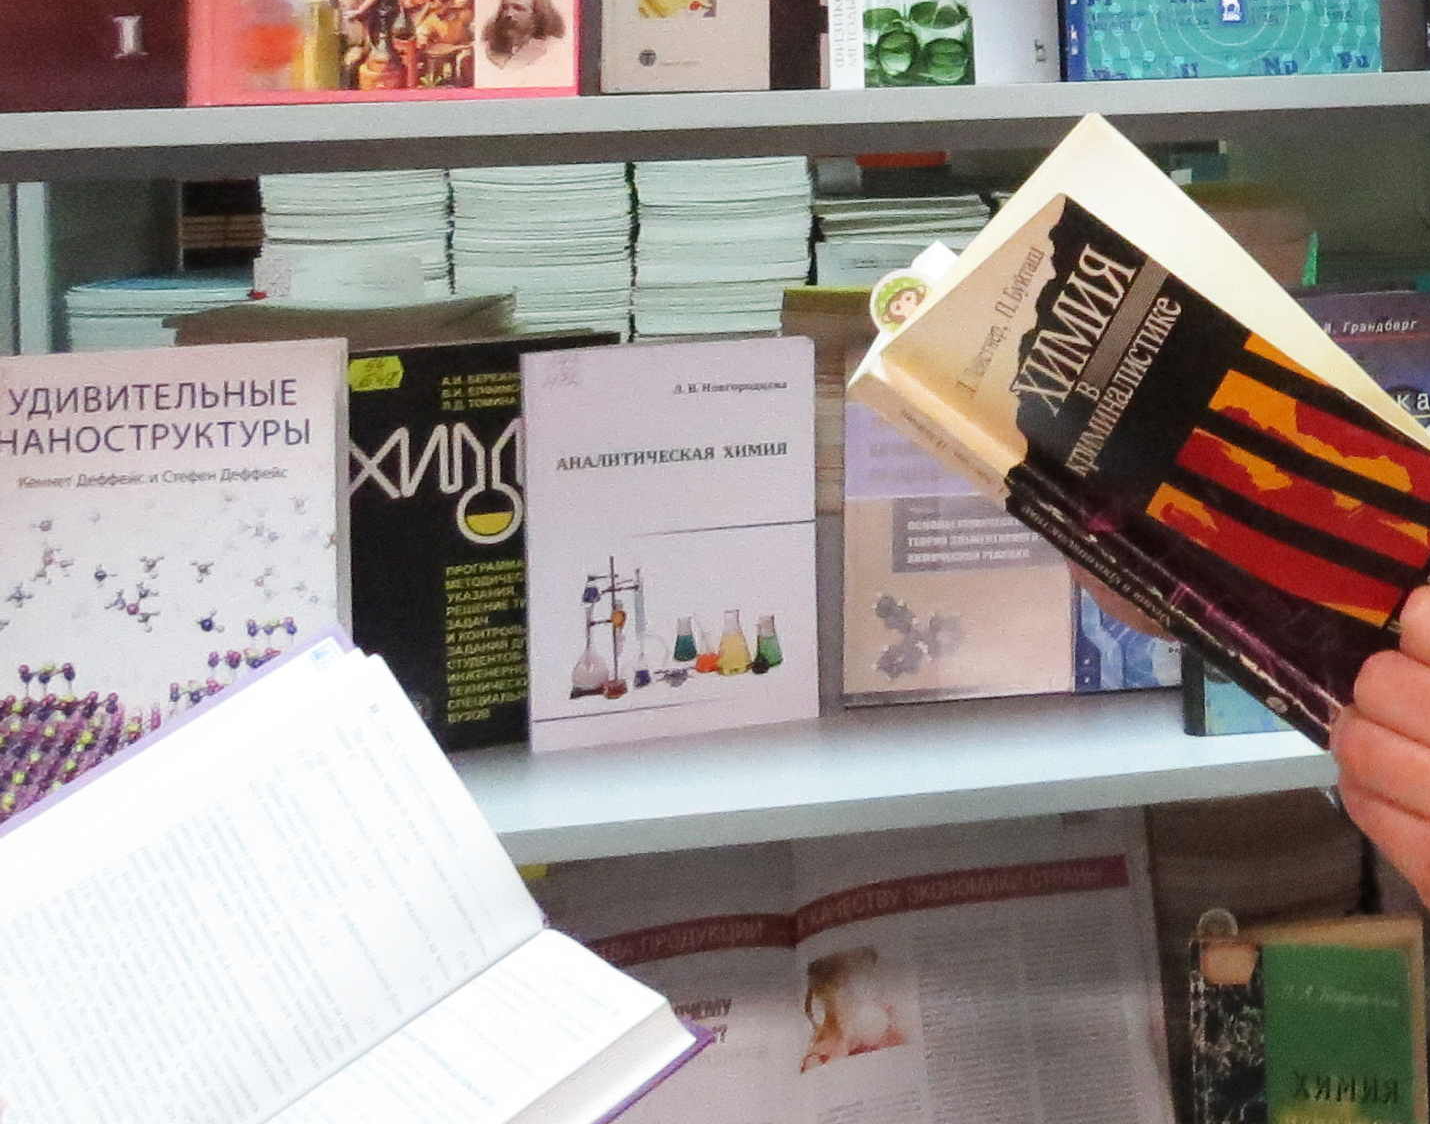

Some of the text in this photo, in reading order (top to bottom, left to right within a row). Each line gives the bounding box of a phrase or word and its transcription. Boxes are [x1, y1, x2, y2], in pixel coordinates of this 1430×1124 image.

[1009, 243, 1137, 417] ХИМИЯ
[8, 379, 297, 420] УДИВИТЕЛЬНЫЕ
[556, 441, 788, 472] АНАЛИТИЧЕСКАЯ ХИМИЯ
